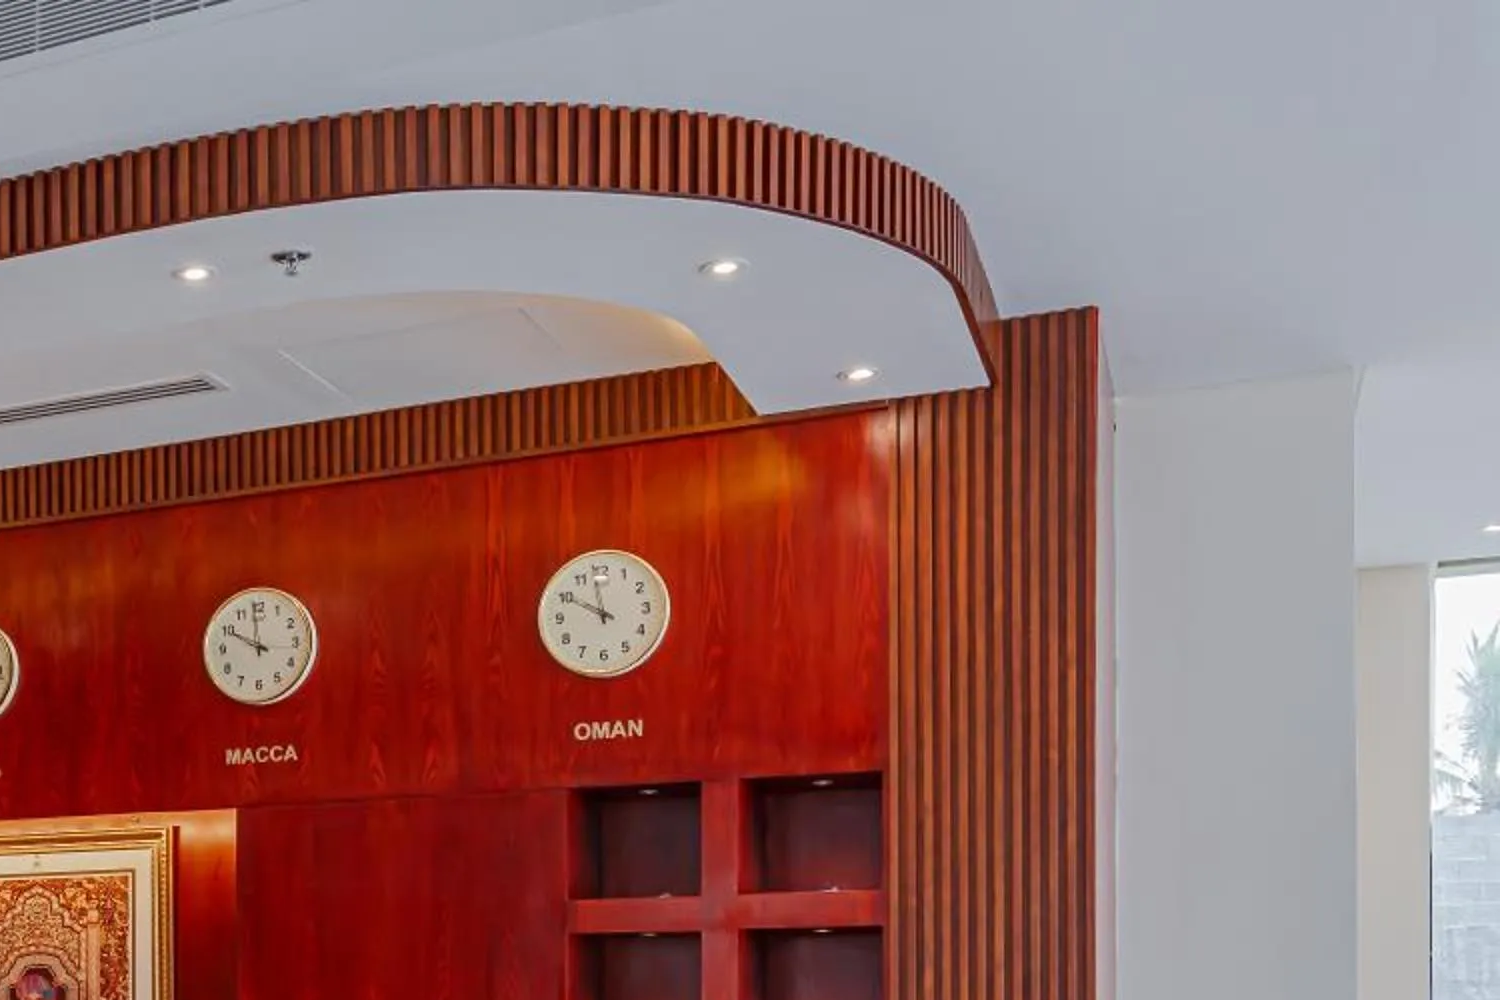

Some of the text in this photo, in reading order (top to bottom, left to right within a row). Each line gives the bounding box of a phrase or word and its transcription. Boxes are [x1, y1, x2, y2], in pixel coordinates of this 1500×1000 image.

[621, 568, 626, 579] 1
[575, 574, 586, 585] 11
[635, 582, 644, 593] 2
[559, 592, 573, 602] 10
[275, 605, 279, 615] 1
[641, 602, 650, 614] 3
[237, 610, 245, 620] 11
[556, 613, 564, 624] 9
[287, 618, 294, 628] 2
[223, 624, 234, 636] 10
[636, 624, 644, 634] 4
[292, 637, 298, 648] 3
[562, 633, 570, 644] 8
[219, 643, 226, 654] 9
[578, 646, 586, 658] 7
[621, 641, 630, 652] 5
[600, 650, 608, 660] 6
[287, 657, 294, 666] 4
[224, 663, 231, 674] 8
[237, 676, 244, 686] 7
[274, 672, 280, 682] 5
[256, 680, 262, 690] 6
[573, 719, 644, 741] OMAN
[225, 745, 298, 766] MACCA
